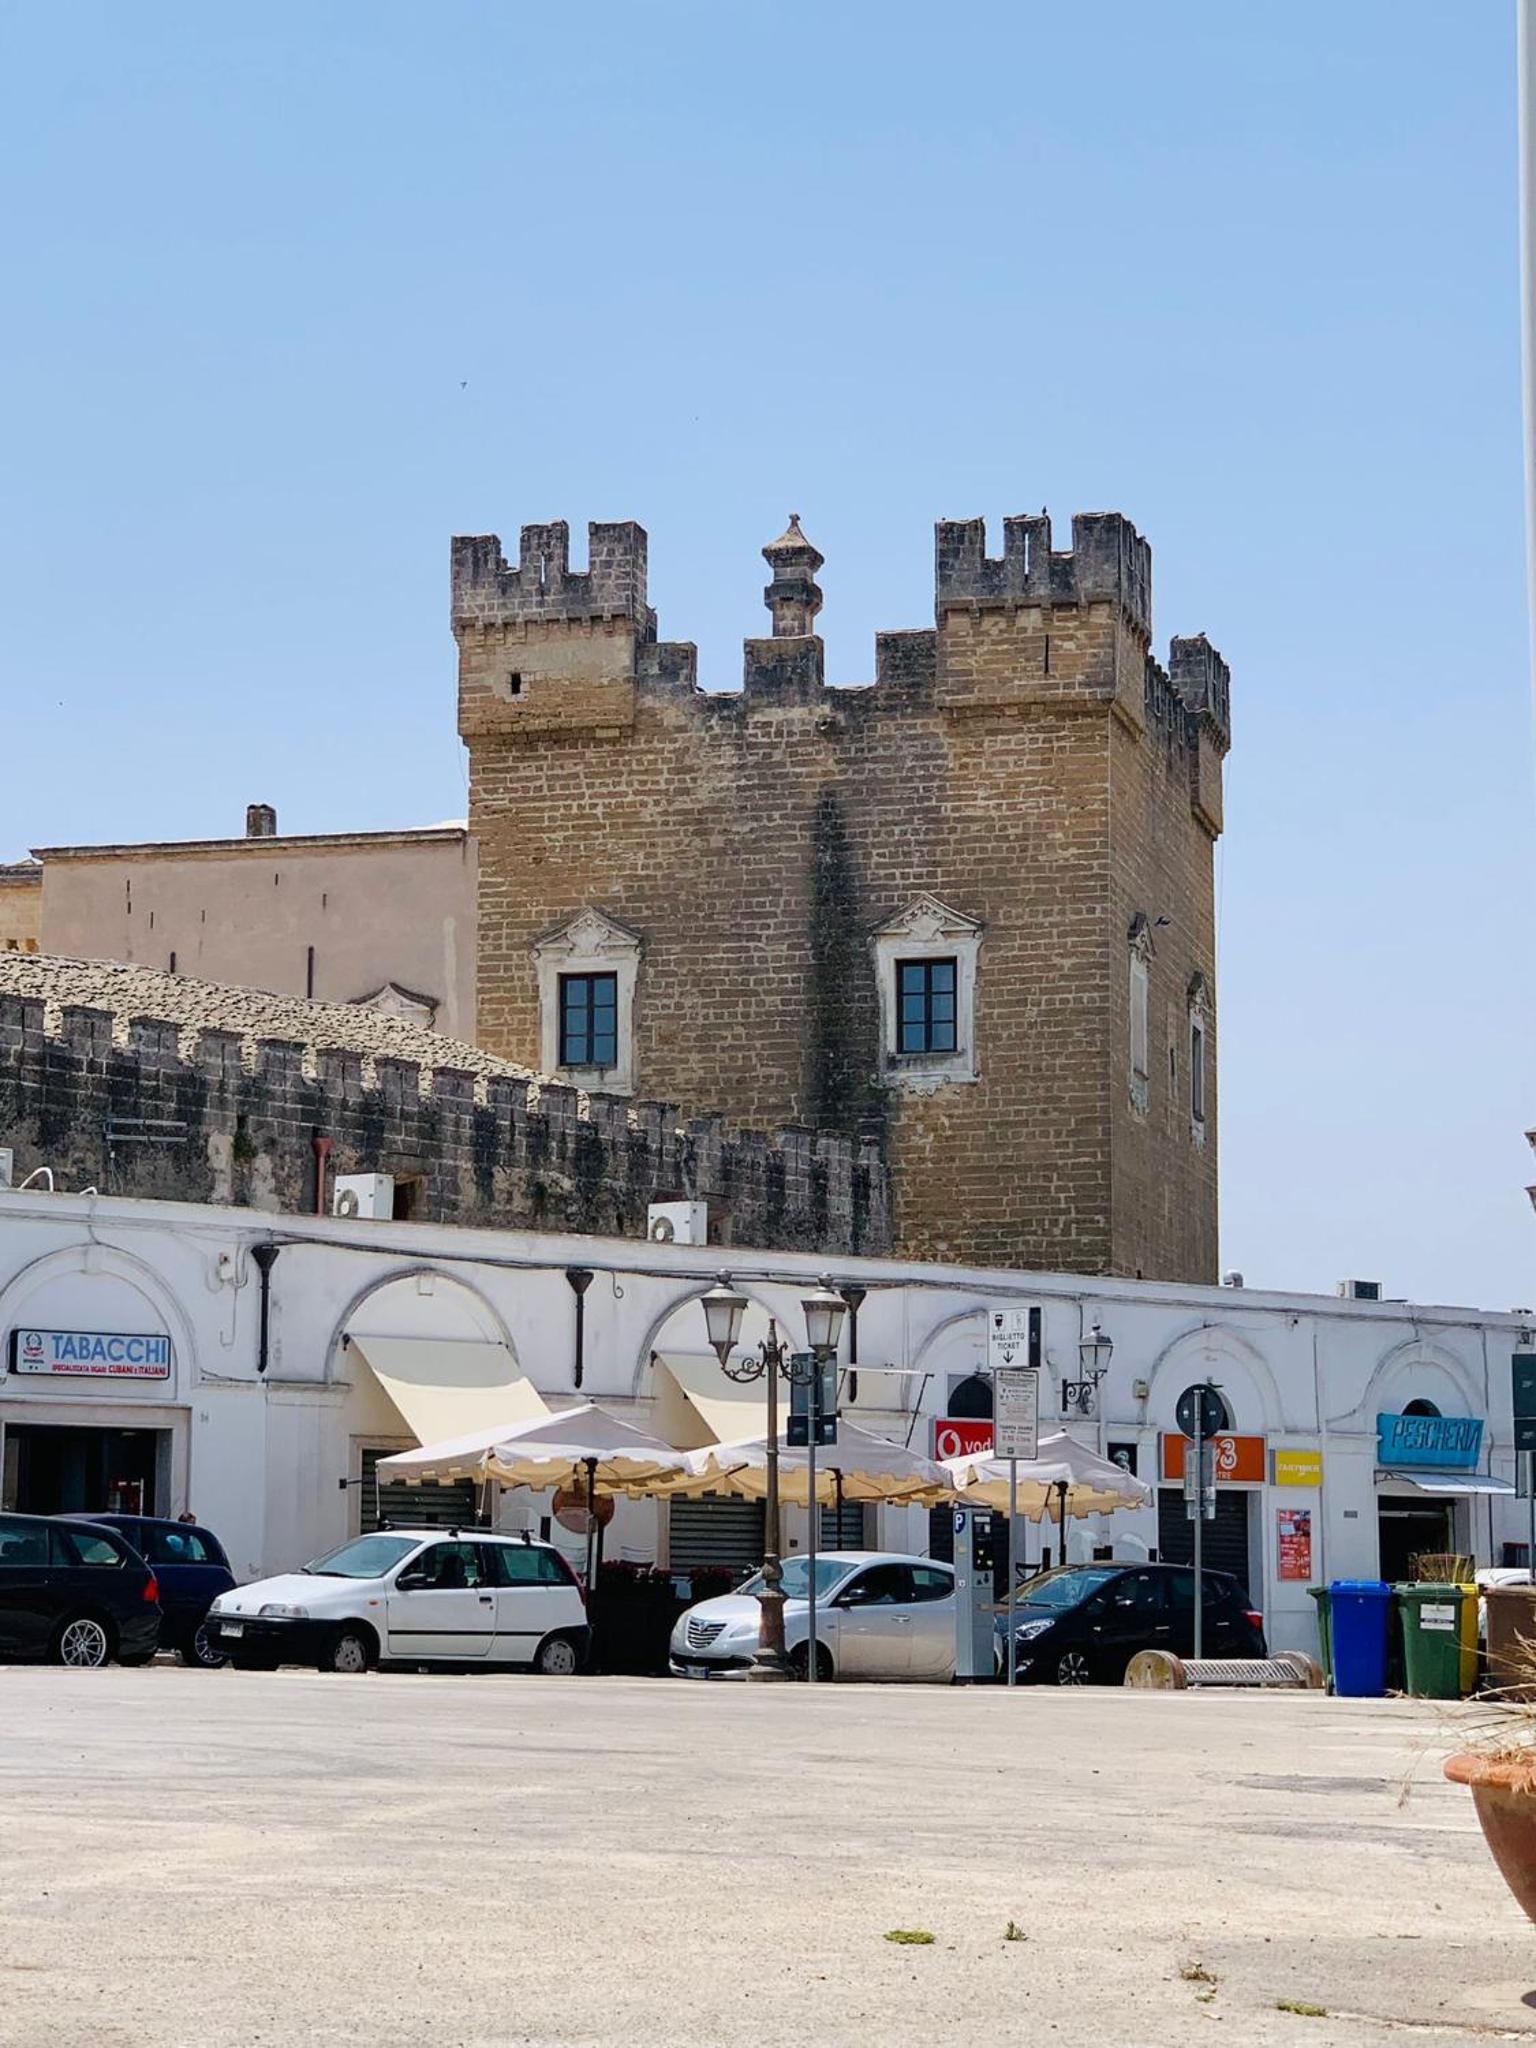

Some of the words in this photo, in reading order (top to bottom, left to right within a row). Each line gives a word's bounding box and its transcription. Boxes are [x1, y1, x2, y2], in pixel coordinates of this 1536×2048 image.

[992, 1332, 1025, 1342] BIGLIETTO
[52, 1335, 166, 1363] TABACCHI
[997, 1341, 1020, 1351] TICKET
[138, 1366, 166, 1376] ITALIANI
[1391, 1419, 1481, 1453] PESCHERIA
